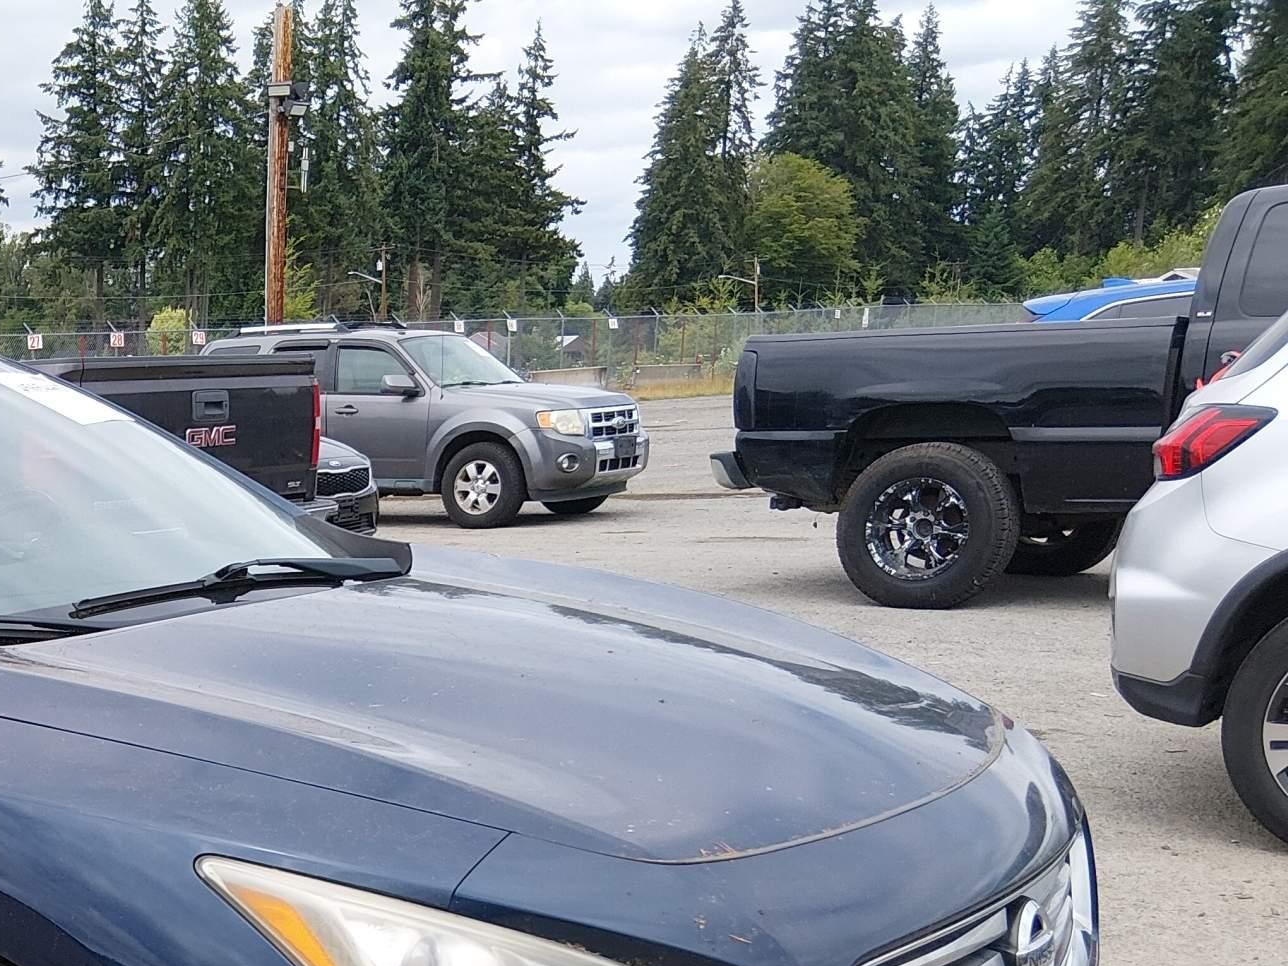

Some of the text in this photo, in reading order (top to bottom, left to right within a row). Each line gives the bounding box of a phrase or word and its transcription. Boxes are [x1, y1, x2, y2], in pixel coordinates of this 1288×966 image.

[29, 335, 40, 348] 27
[111, 334, 123, 347] 28
[185, 424, 237, 448] GMC
